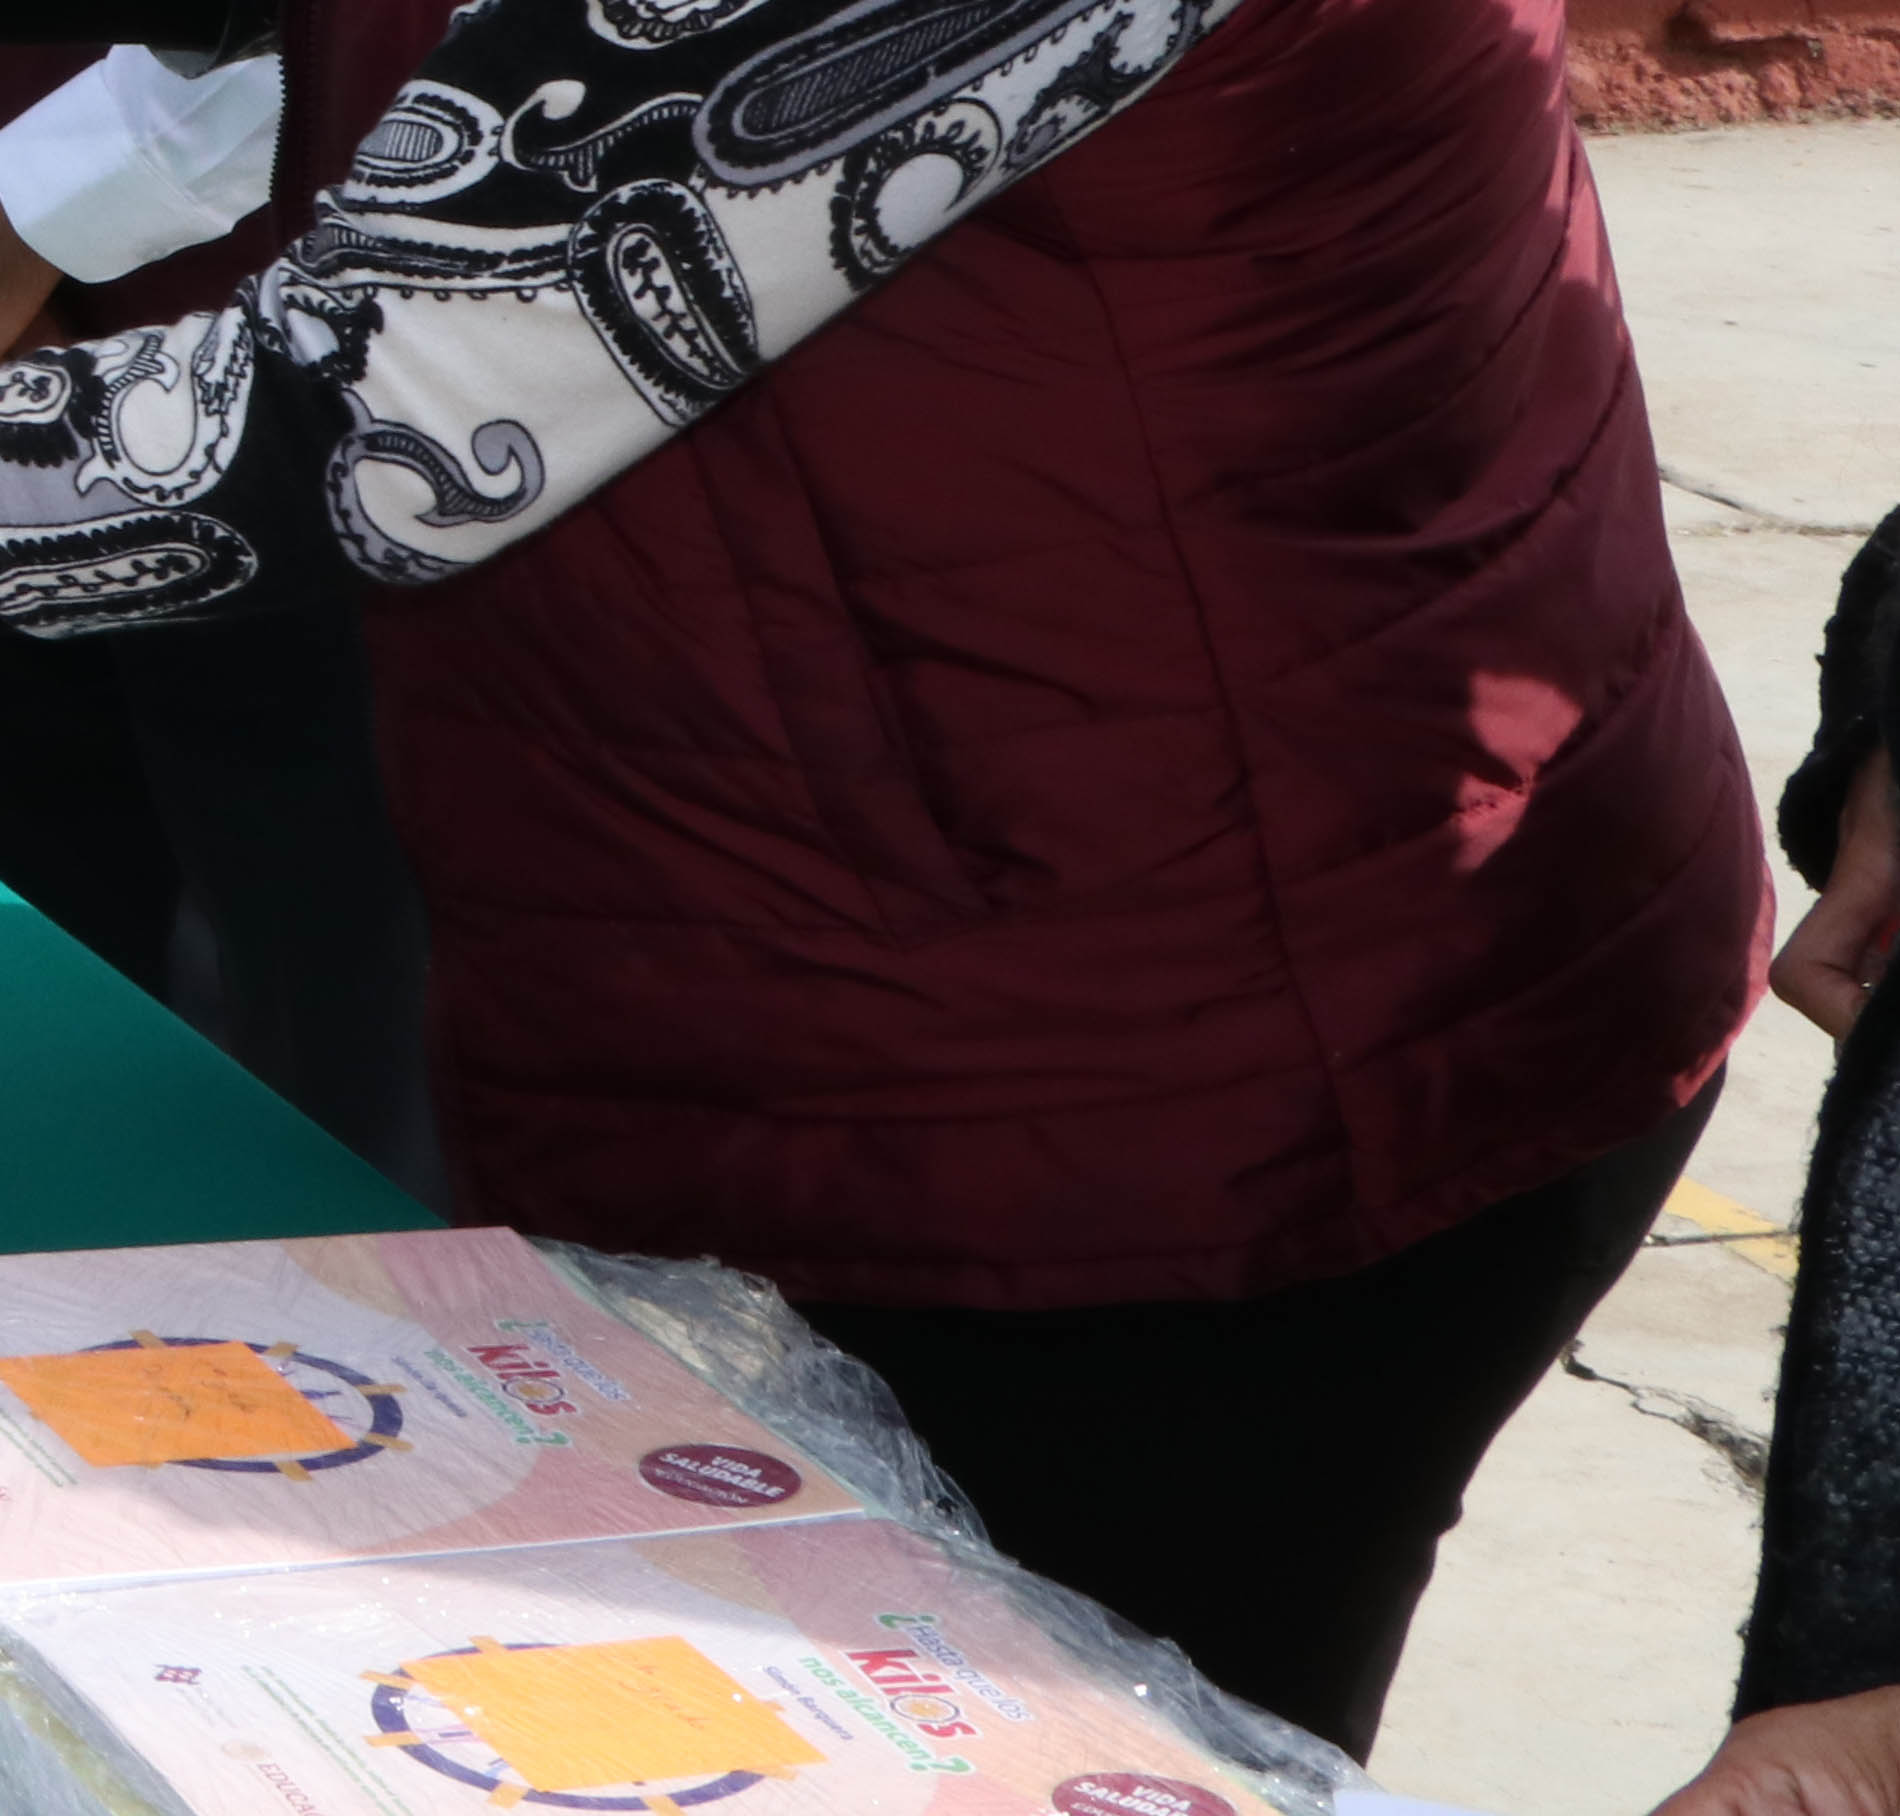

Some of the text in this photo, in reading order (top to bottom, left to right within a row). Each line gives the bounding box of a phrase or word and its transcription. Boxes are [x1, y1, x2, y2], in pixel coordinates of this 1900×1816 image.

[658, 1452, 786, 1499] SALUDABLE
[711, 1455, 763, 1478] VIDA
[799, 1655, 843, 1688] nos
[997, 1695, 1034, 1721] los
[1131, 1784, 1193, 1812] VIDA
